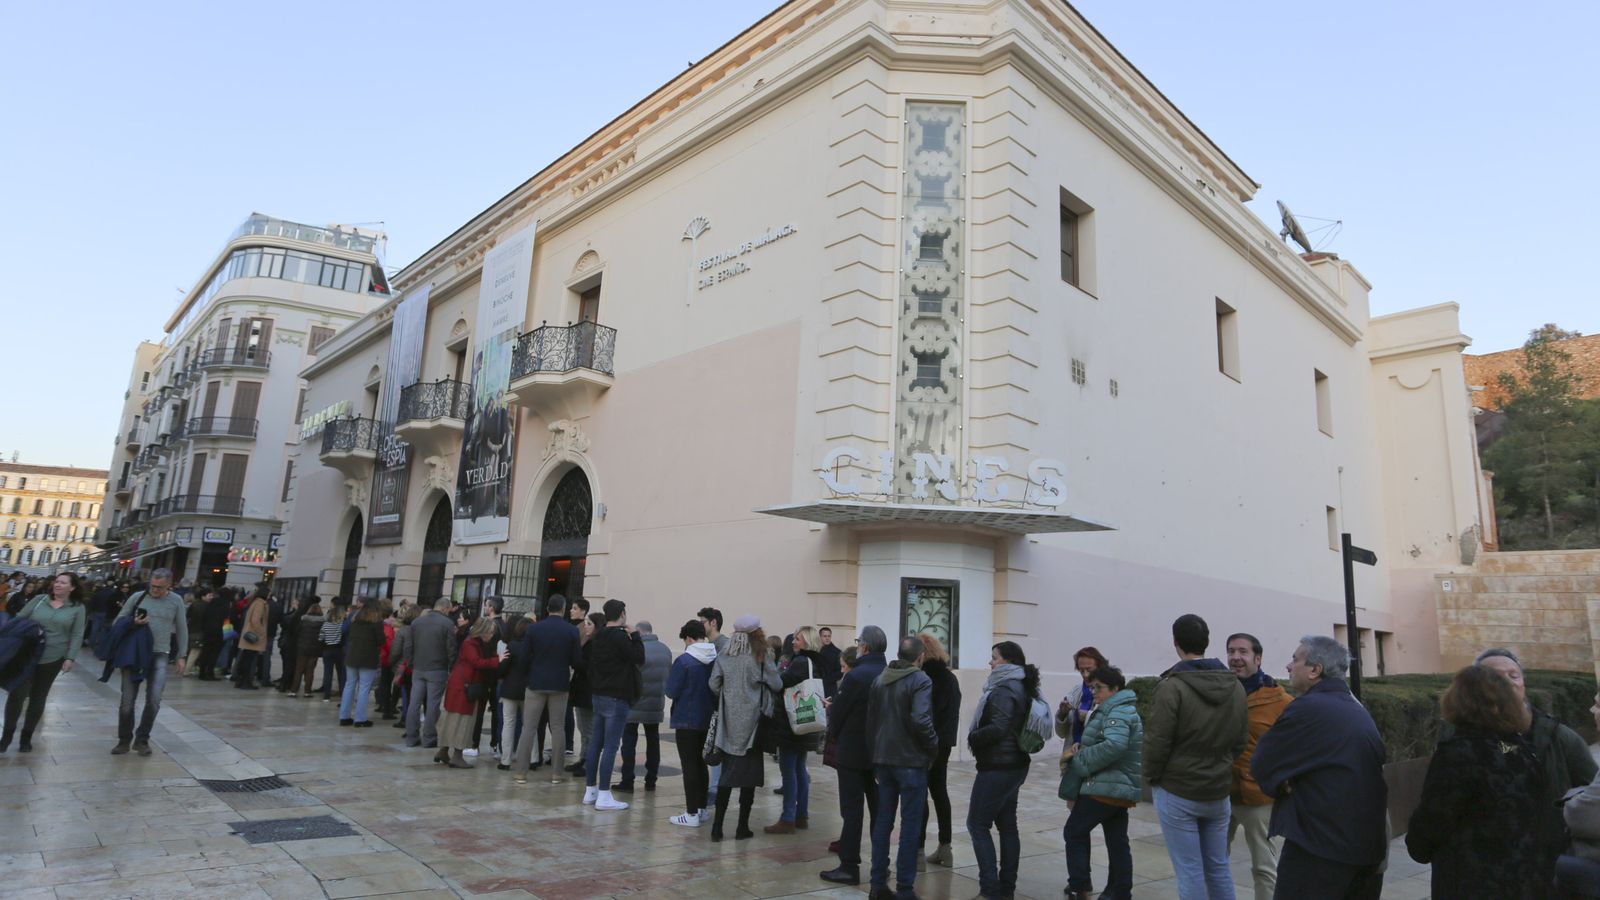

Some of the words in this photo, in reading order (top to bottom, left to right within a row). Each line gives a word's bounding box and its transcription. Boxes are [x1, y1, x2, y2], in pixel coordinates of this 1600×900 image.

[699, 251, 738, 273] FESTIVAL
[740, 242, 753, 256] DE
[698, 275, 714, 291] CINE
[465, 461, 509, 486] VERDAD
[818, 446, 1069, 507] CINES
